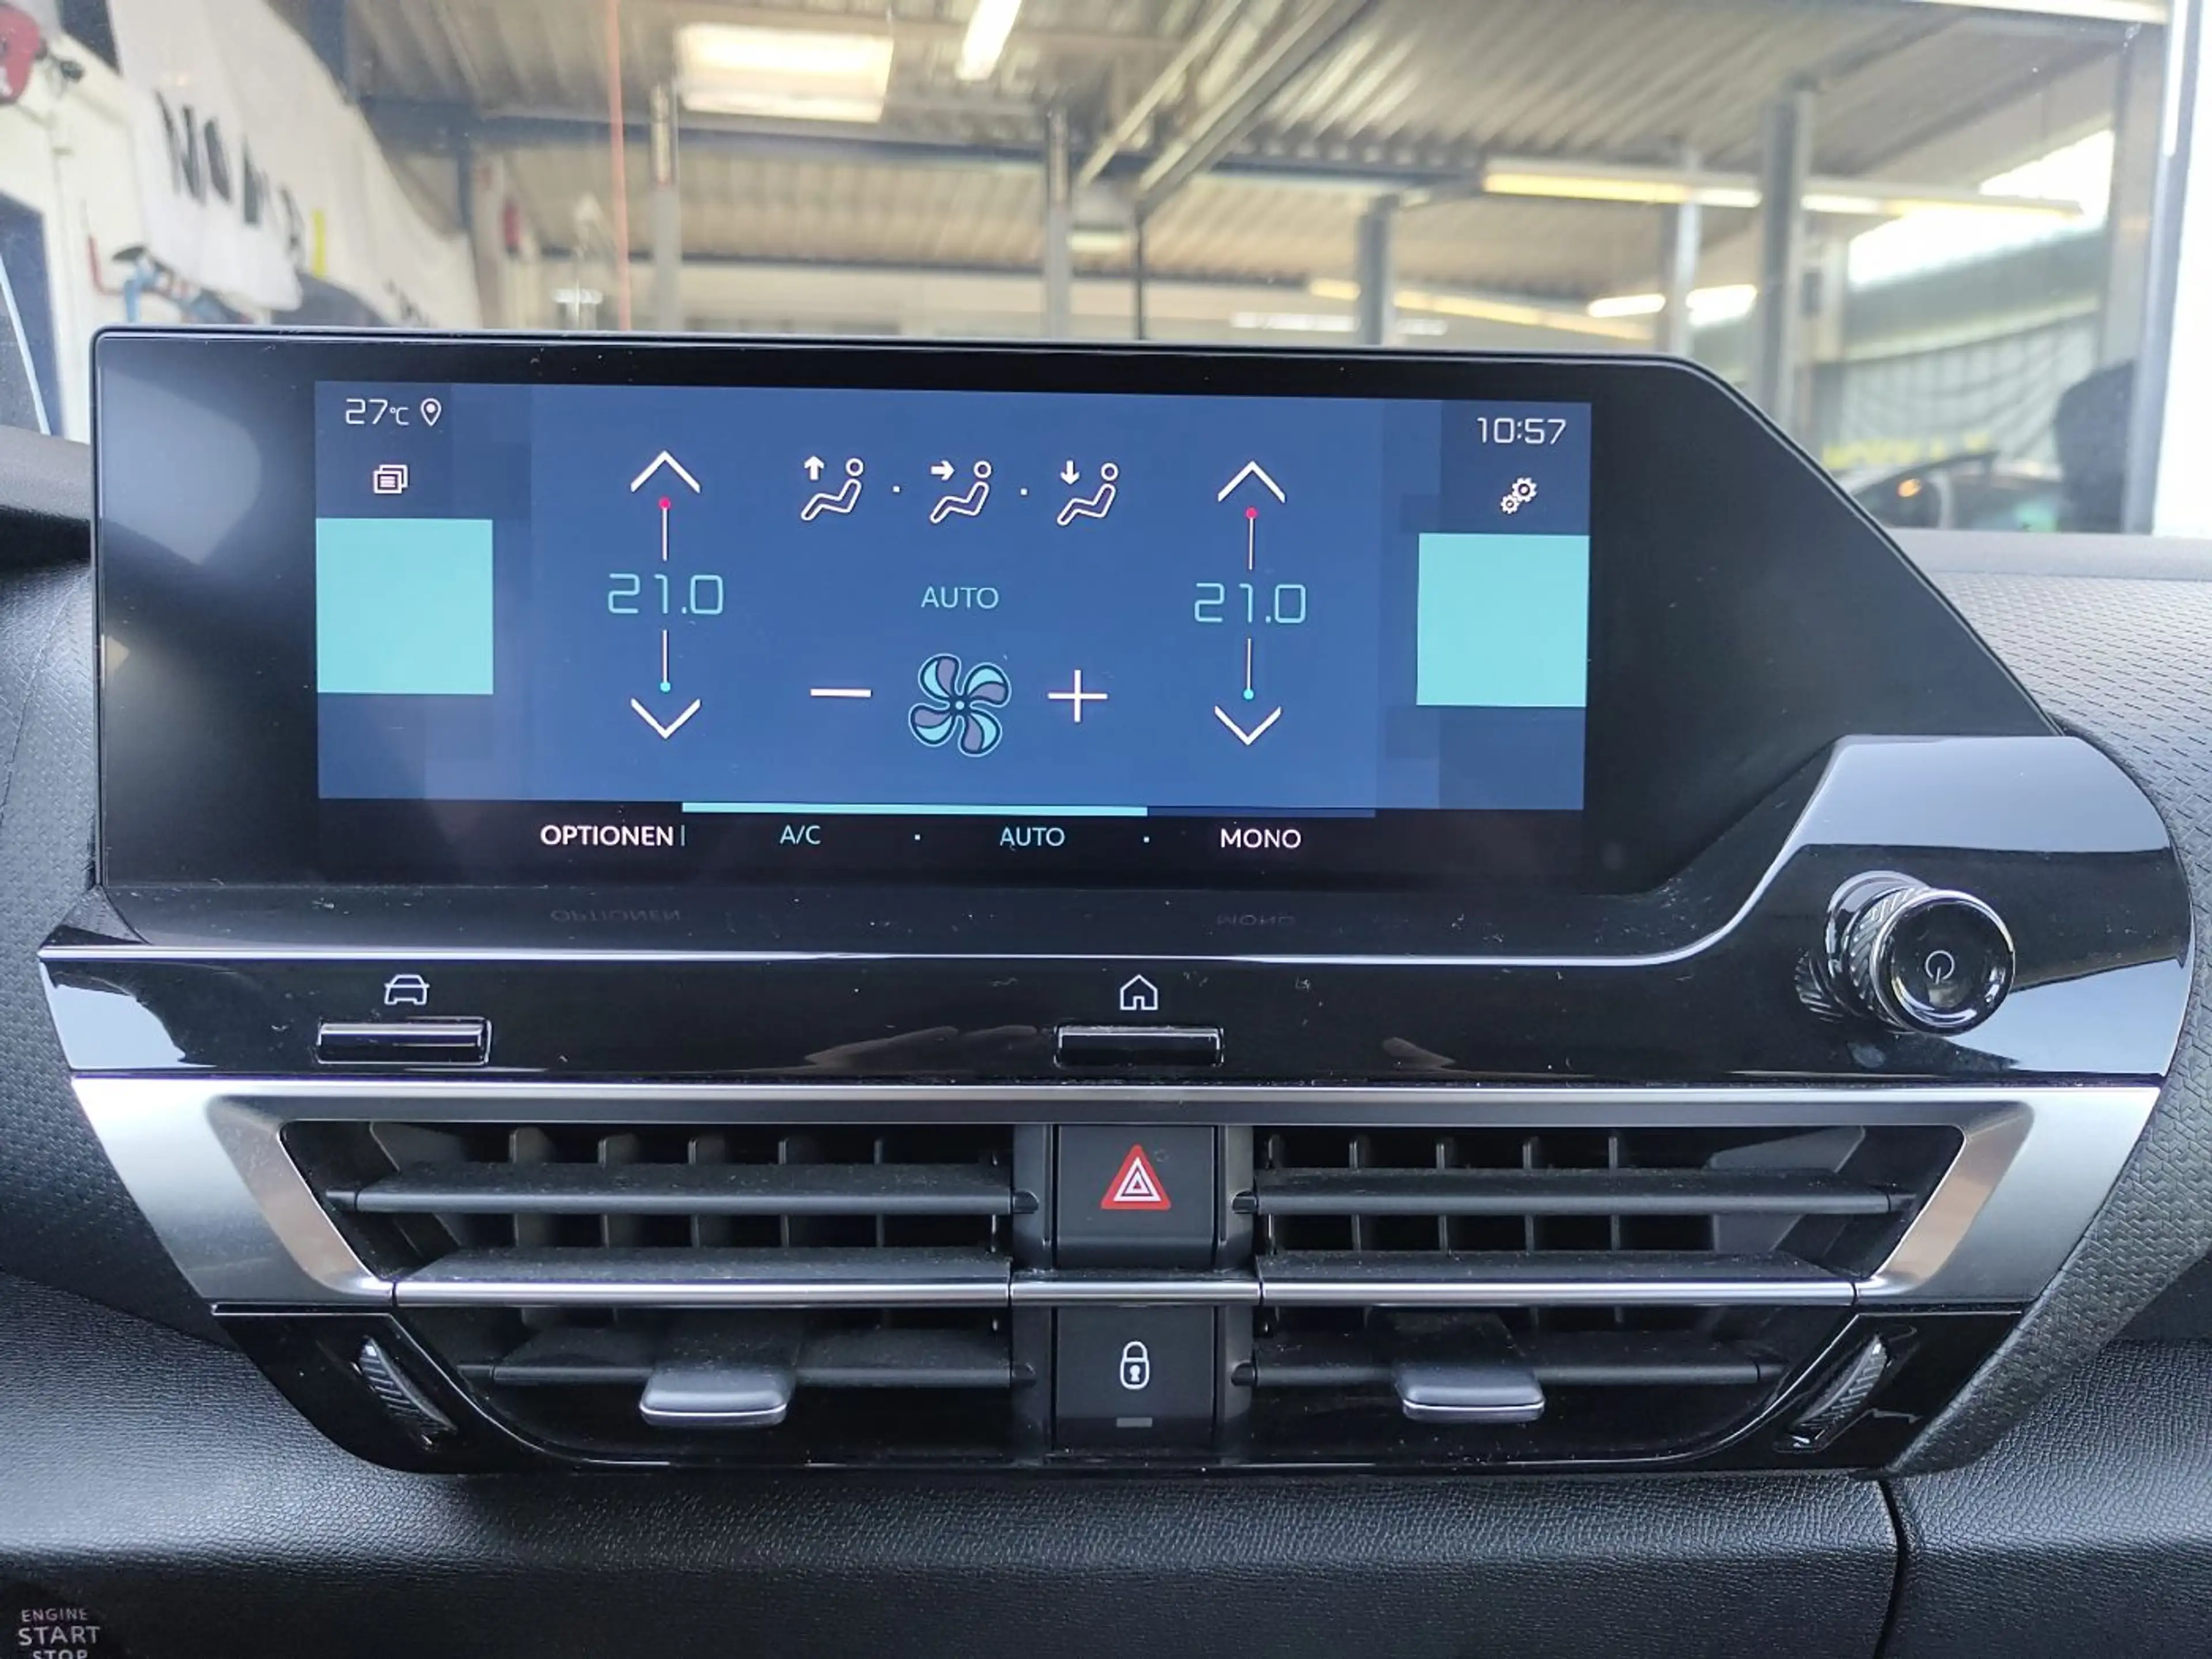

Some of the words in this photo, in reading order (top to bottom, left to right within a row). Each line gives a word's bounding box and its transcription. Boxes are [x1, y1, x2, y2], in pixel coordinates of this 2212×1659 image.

[1476, 416, 1567, 445] 10:57
[608, 573, 724, 615] 21.0
[921, 586, 999, 609] AUTO
[1194, 582, 1306, 624] 21.0
[540, 824, 673, 846] OPTIONEN
[779, 824, 821, 845] A/C
[999, 827, 1066, 847] AUTO
[1220, 828, 1302, 849] MONO
[21, 1607, 88, 1622] ENGINE
[18, 1626, 100, 1646] START
[32, 1649, 88, 1659] STOP
